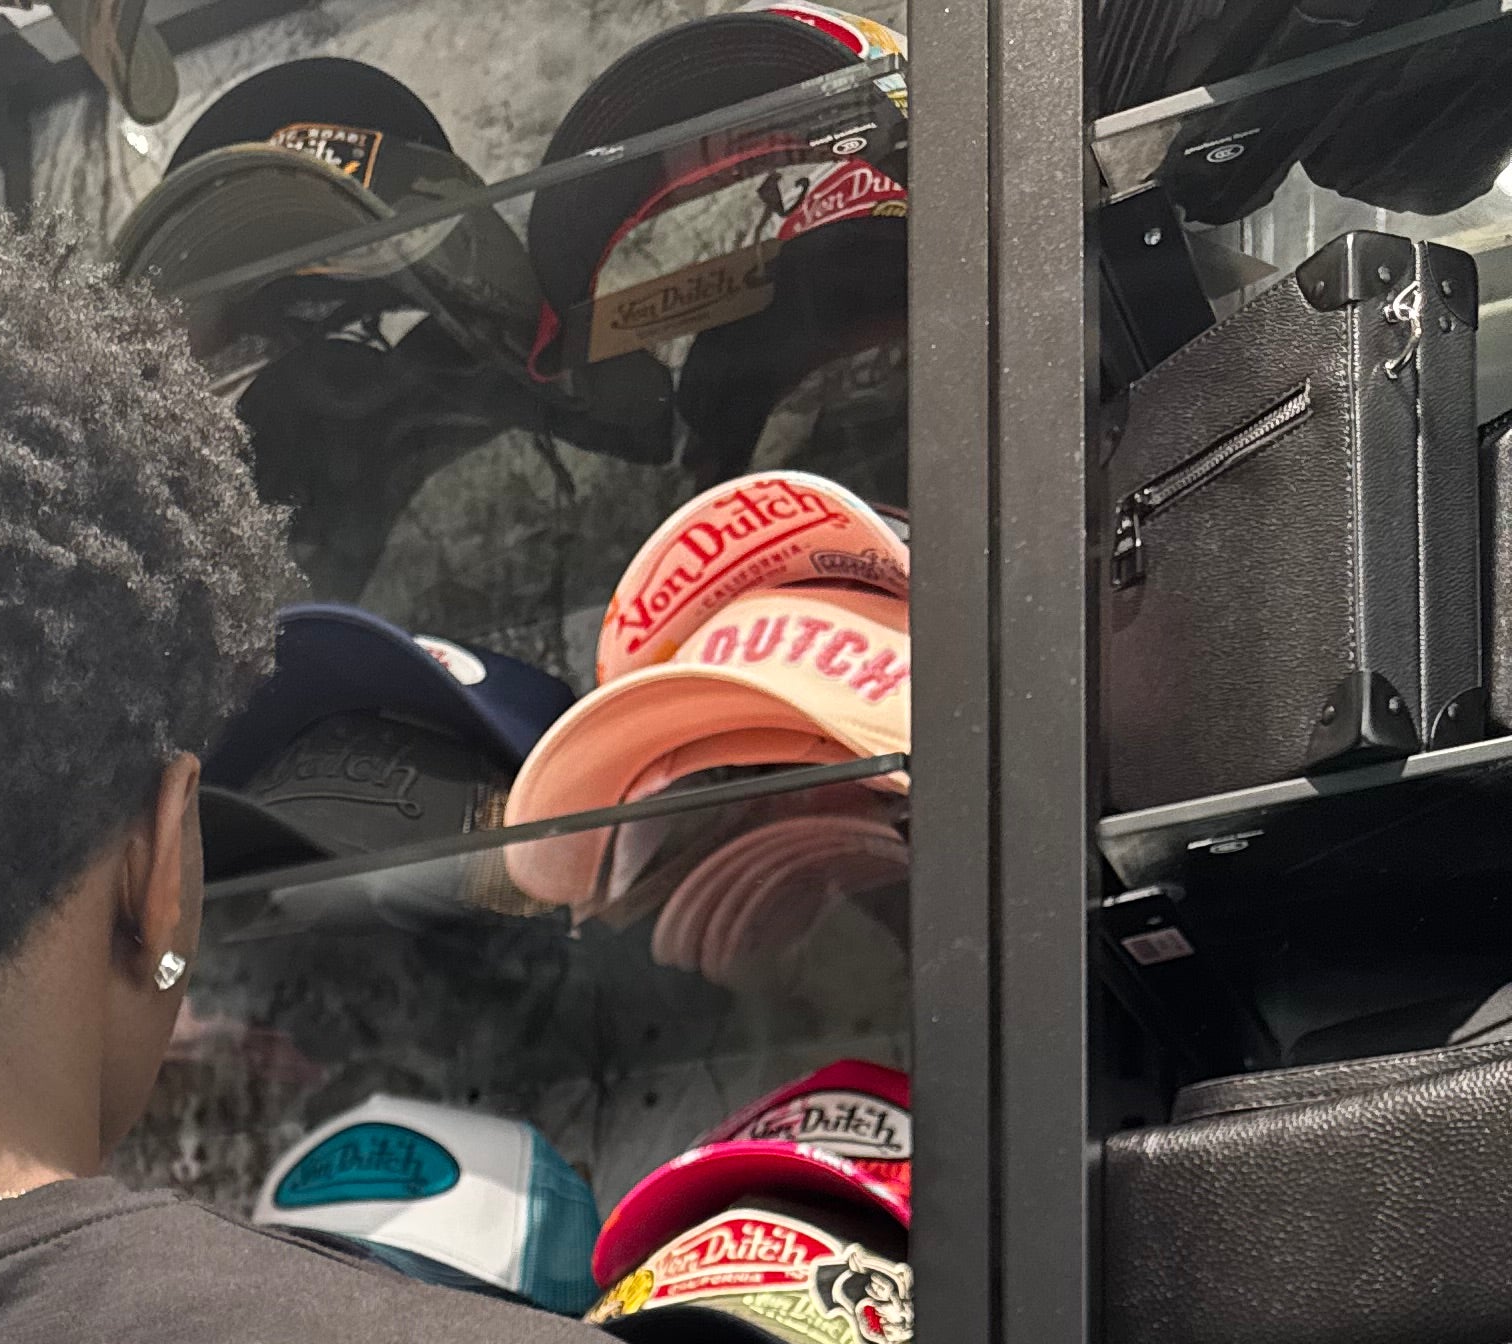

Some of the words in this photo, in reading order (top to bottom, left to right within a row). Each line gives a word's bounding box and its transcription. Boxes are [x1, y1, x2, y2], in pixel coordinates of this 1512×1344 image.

[615, 564, 705, 640] Von
[677, 479, 832, 565] Dutch
[702, 616, 910, 700] DUTCH
[800, 1103, 895, 1146] Dutch
[700, 1222, 808, 1268] Dutch
